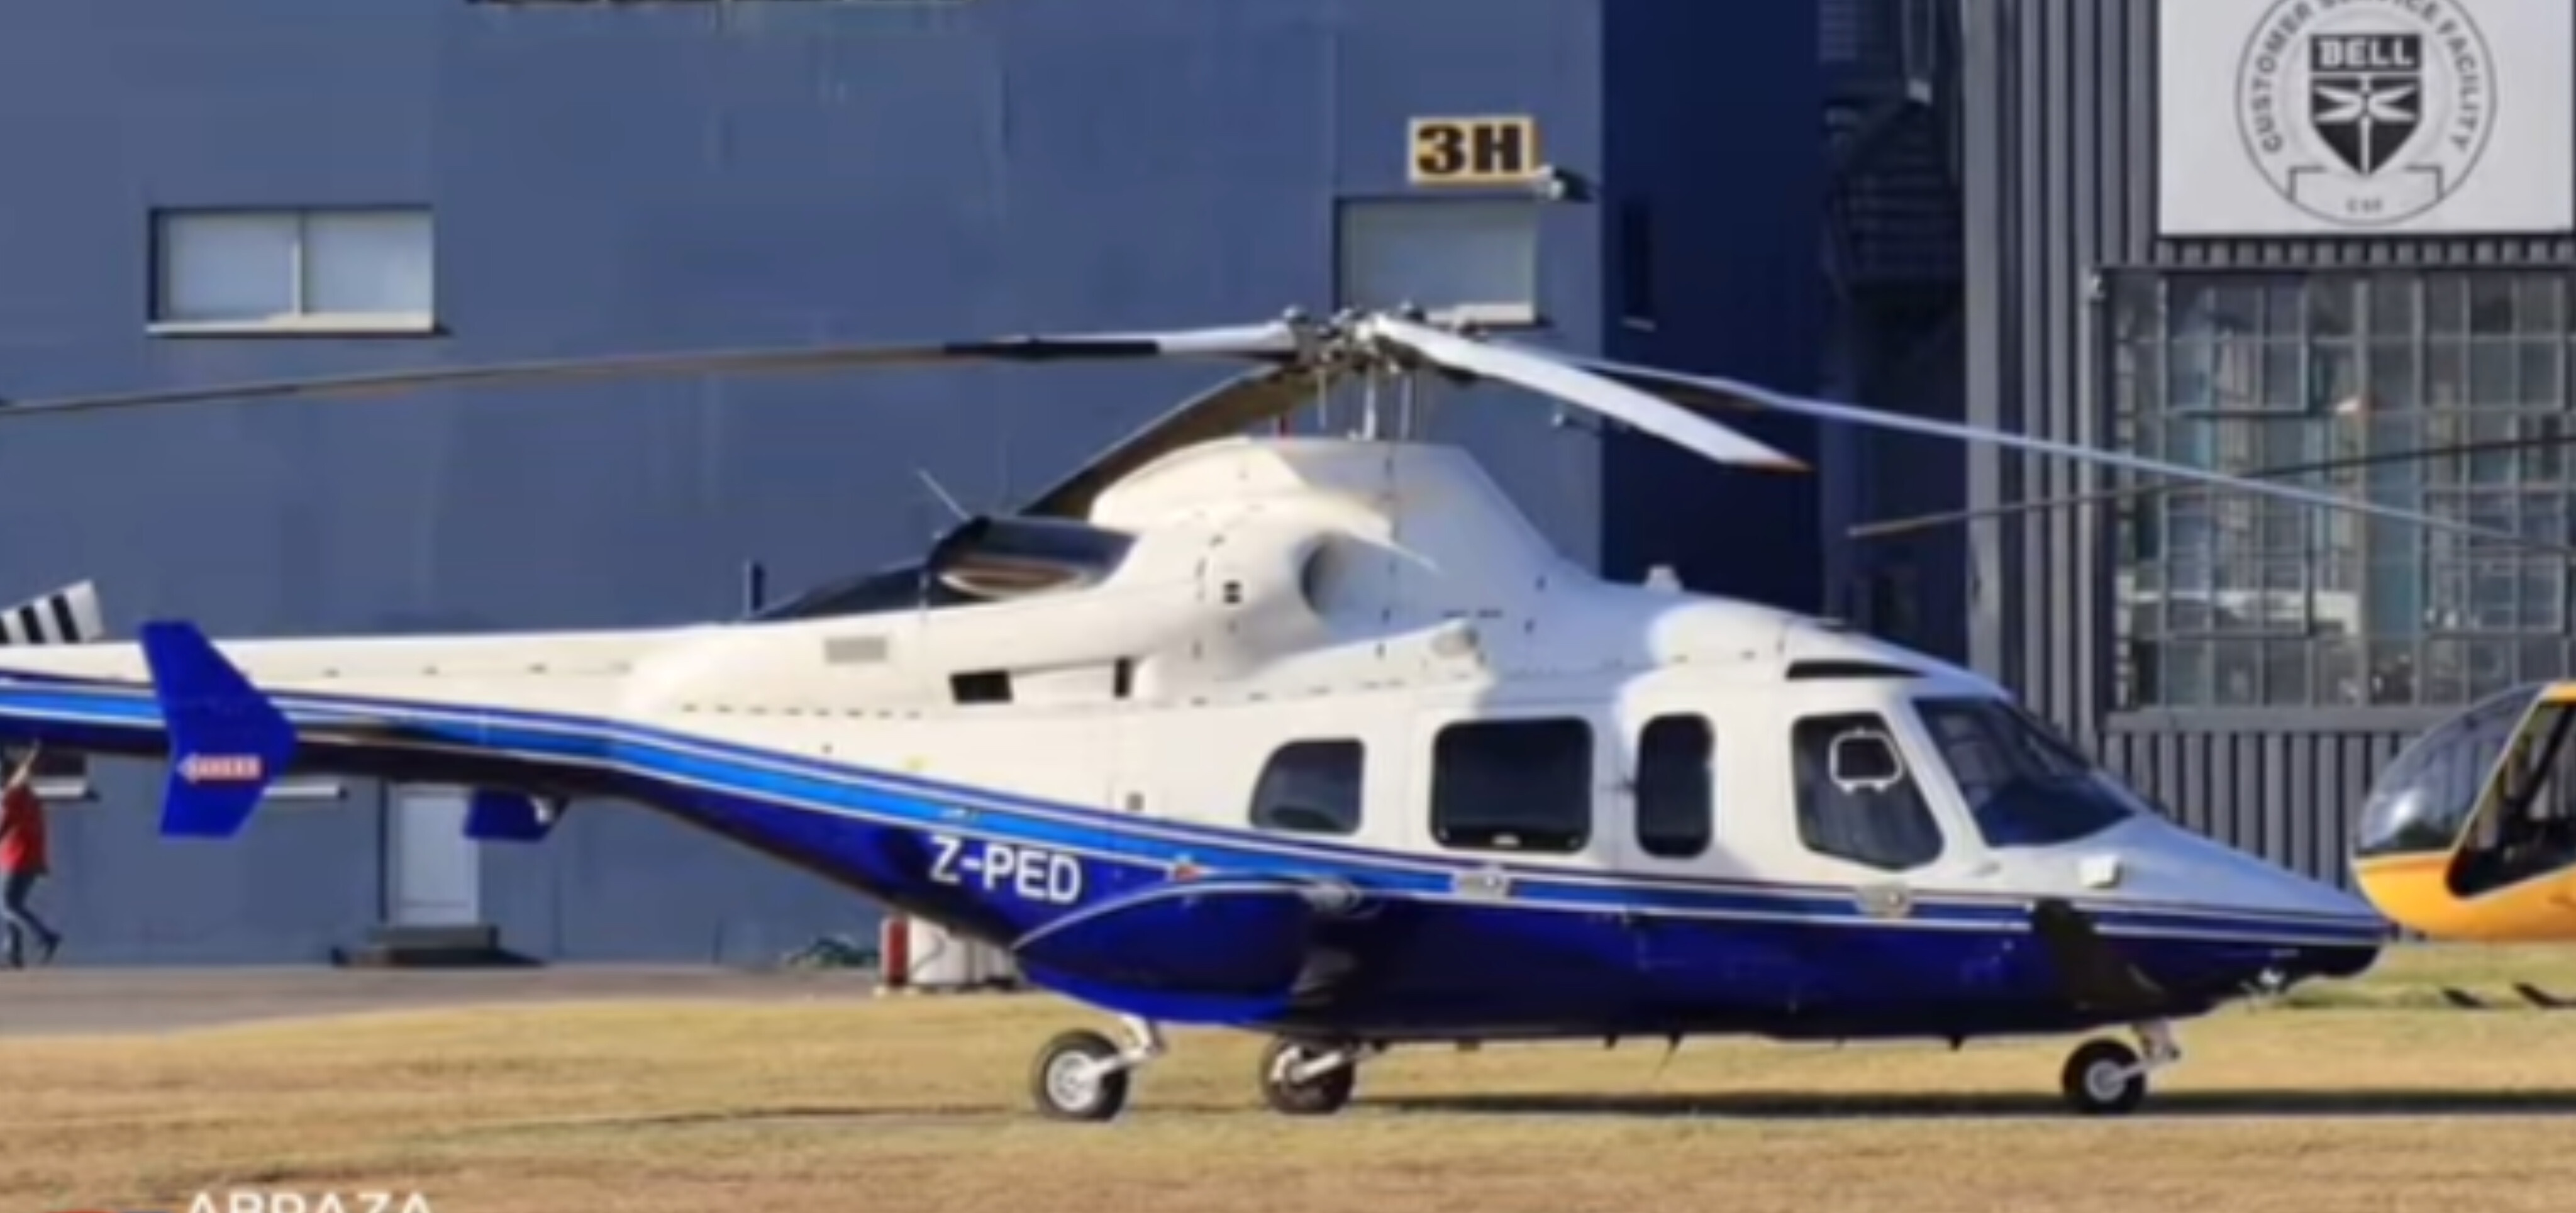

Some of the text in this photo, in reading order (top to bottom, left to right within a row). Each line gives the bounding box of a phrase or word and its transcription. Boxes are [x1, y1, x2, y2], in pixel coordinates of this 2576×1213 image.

[2252, 1, 2480, 152] CUSTOMER FACILITY
[2318, 36, 2415, 67] BELL
[1418, 123, 1522, 175] 3H
[930, 833, 1082, 904] Z-PED
